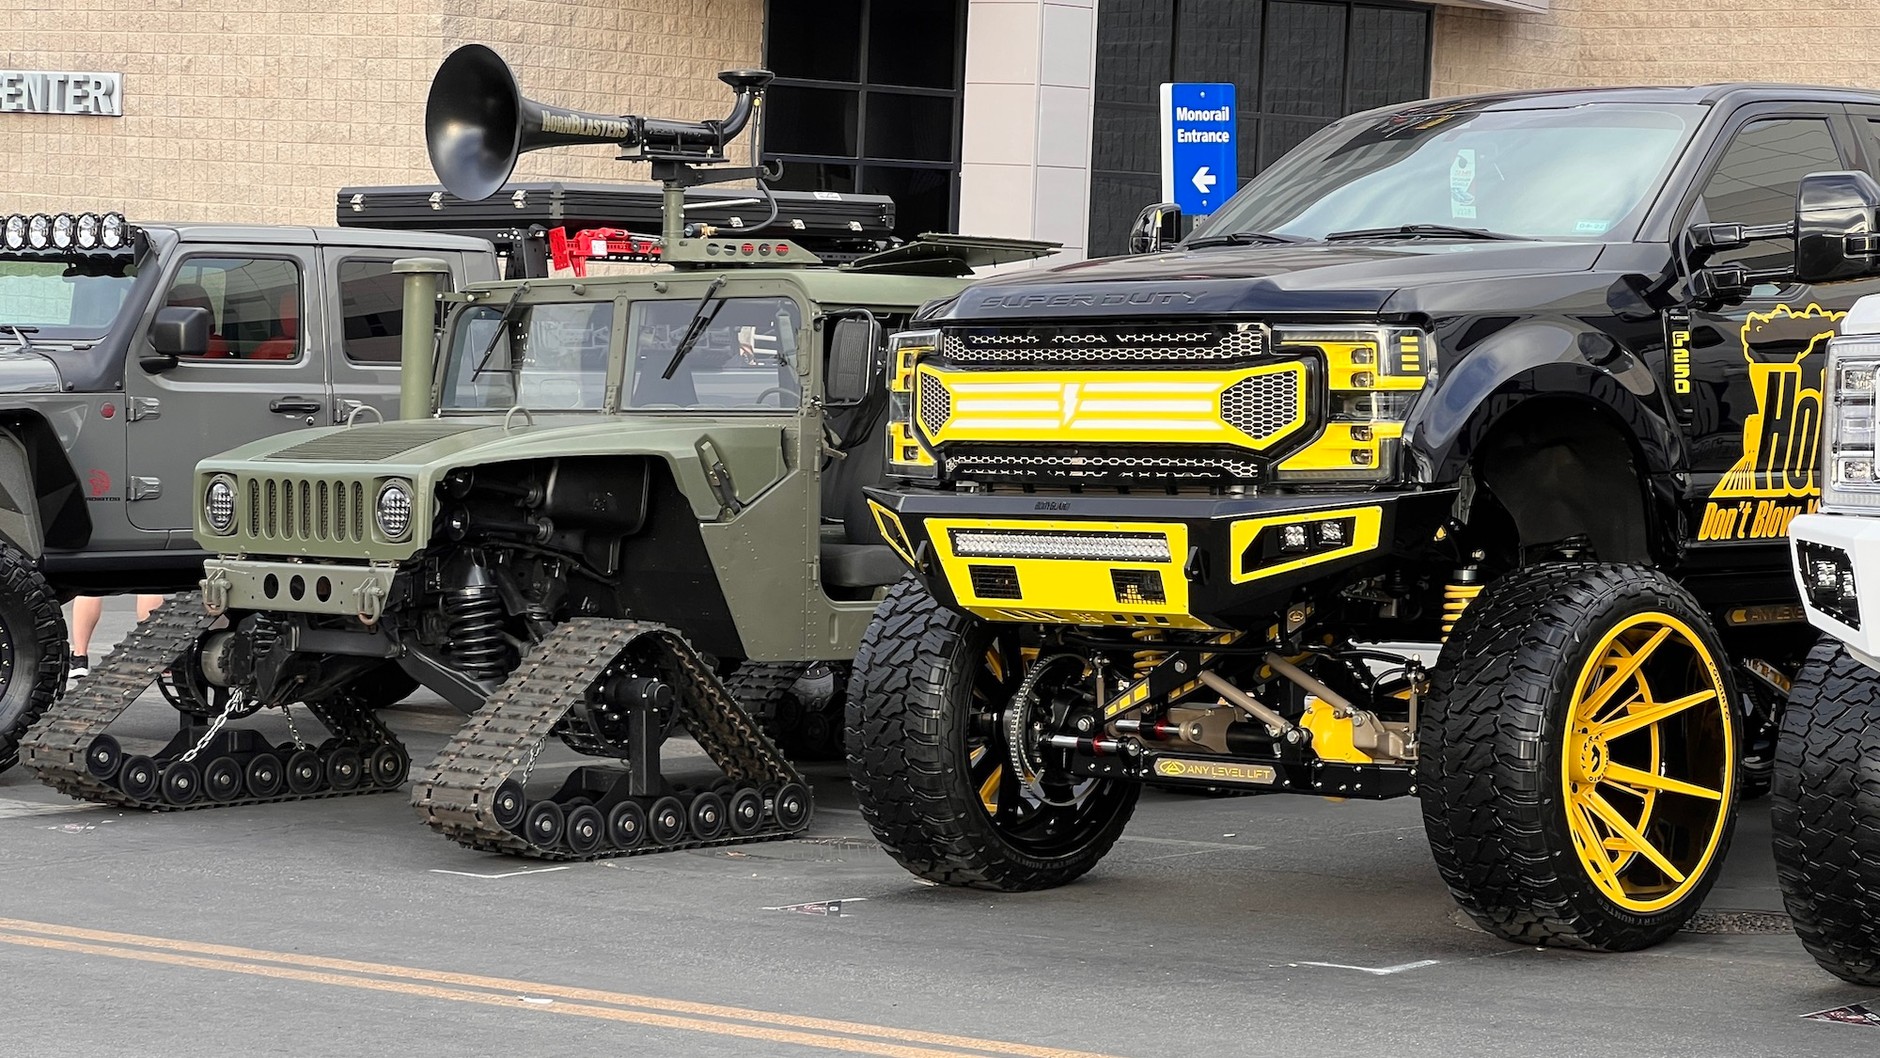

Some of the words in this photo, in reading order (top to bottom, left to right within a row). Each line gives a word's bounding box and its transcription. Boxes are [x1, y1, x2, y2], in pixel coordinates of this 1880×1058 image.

[0, 73, 113, 113] ENTER
[1176, 106, 1230, 121] Monorail
[541, 110, 630, 139] HORNBLASTERS
[1177, 129, 1230, 143] Entrance
[980, 294, 1097, 309] SUPER
[1100, 290, 1208, 306] DUTY
[1698, 501, 1752, 541] Don't
[1186, 765, 1210, 775] ANY
[1211, 766, 1245, 778] LEVEL
[1247, 769, 1271, 779] LIFT
